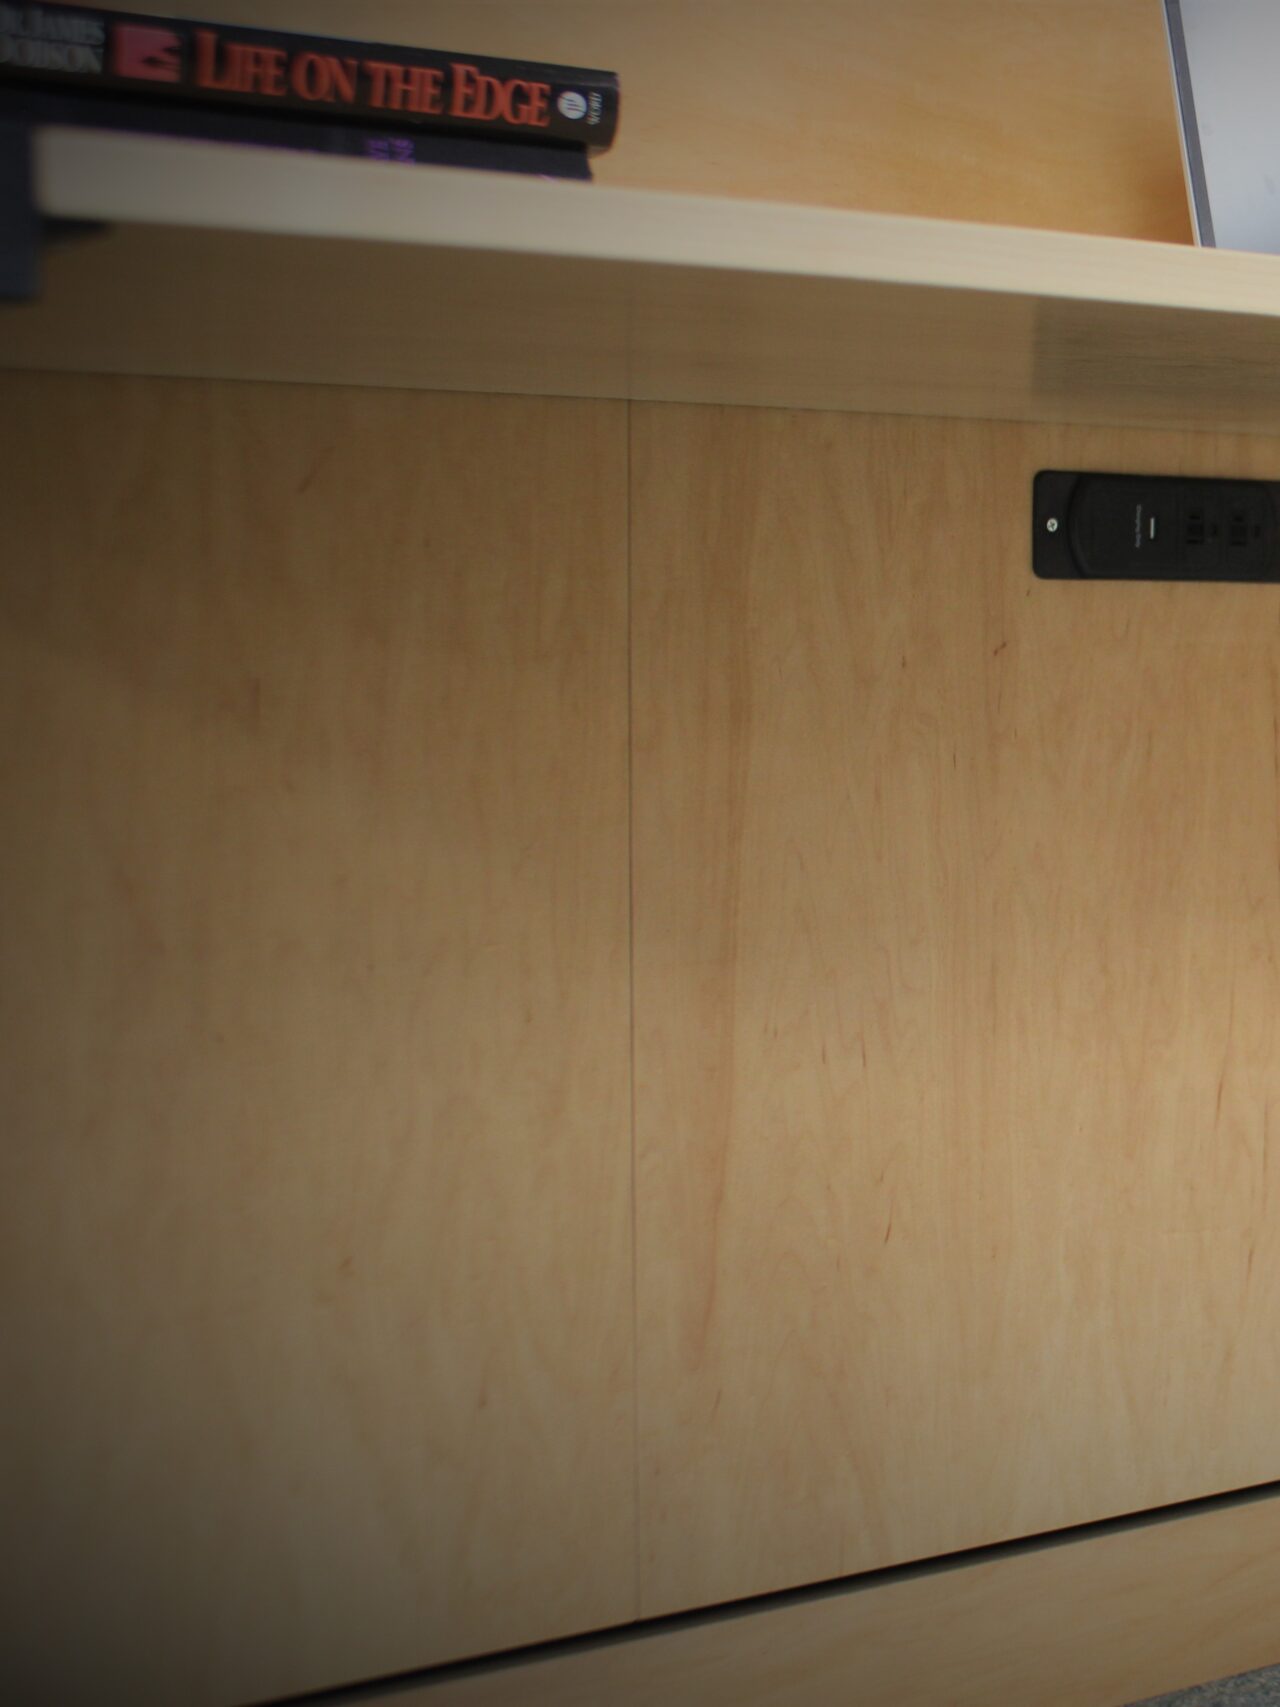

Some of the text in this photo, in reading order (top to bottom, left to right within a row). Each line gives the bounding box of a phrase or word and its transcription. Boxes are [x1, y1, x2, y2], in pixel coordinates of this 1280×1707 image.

[196, 29, 551, 128] LIFE ON THE EDGE
